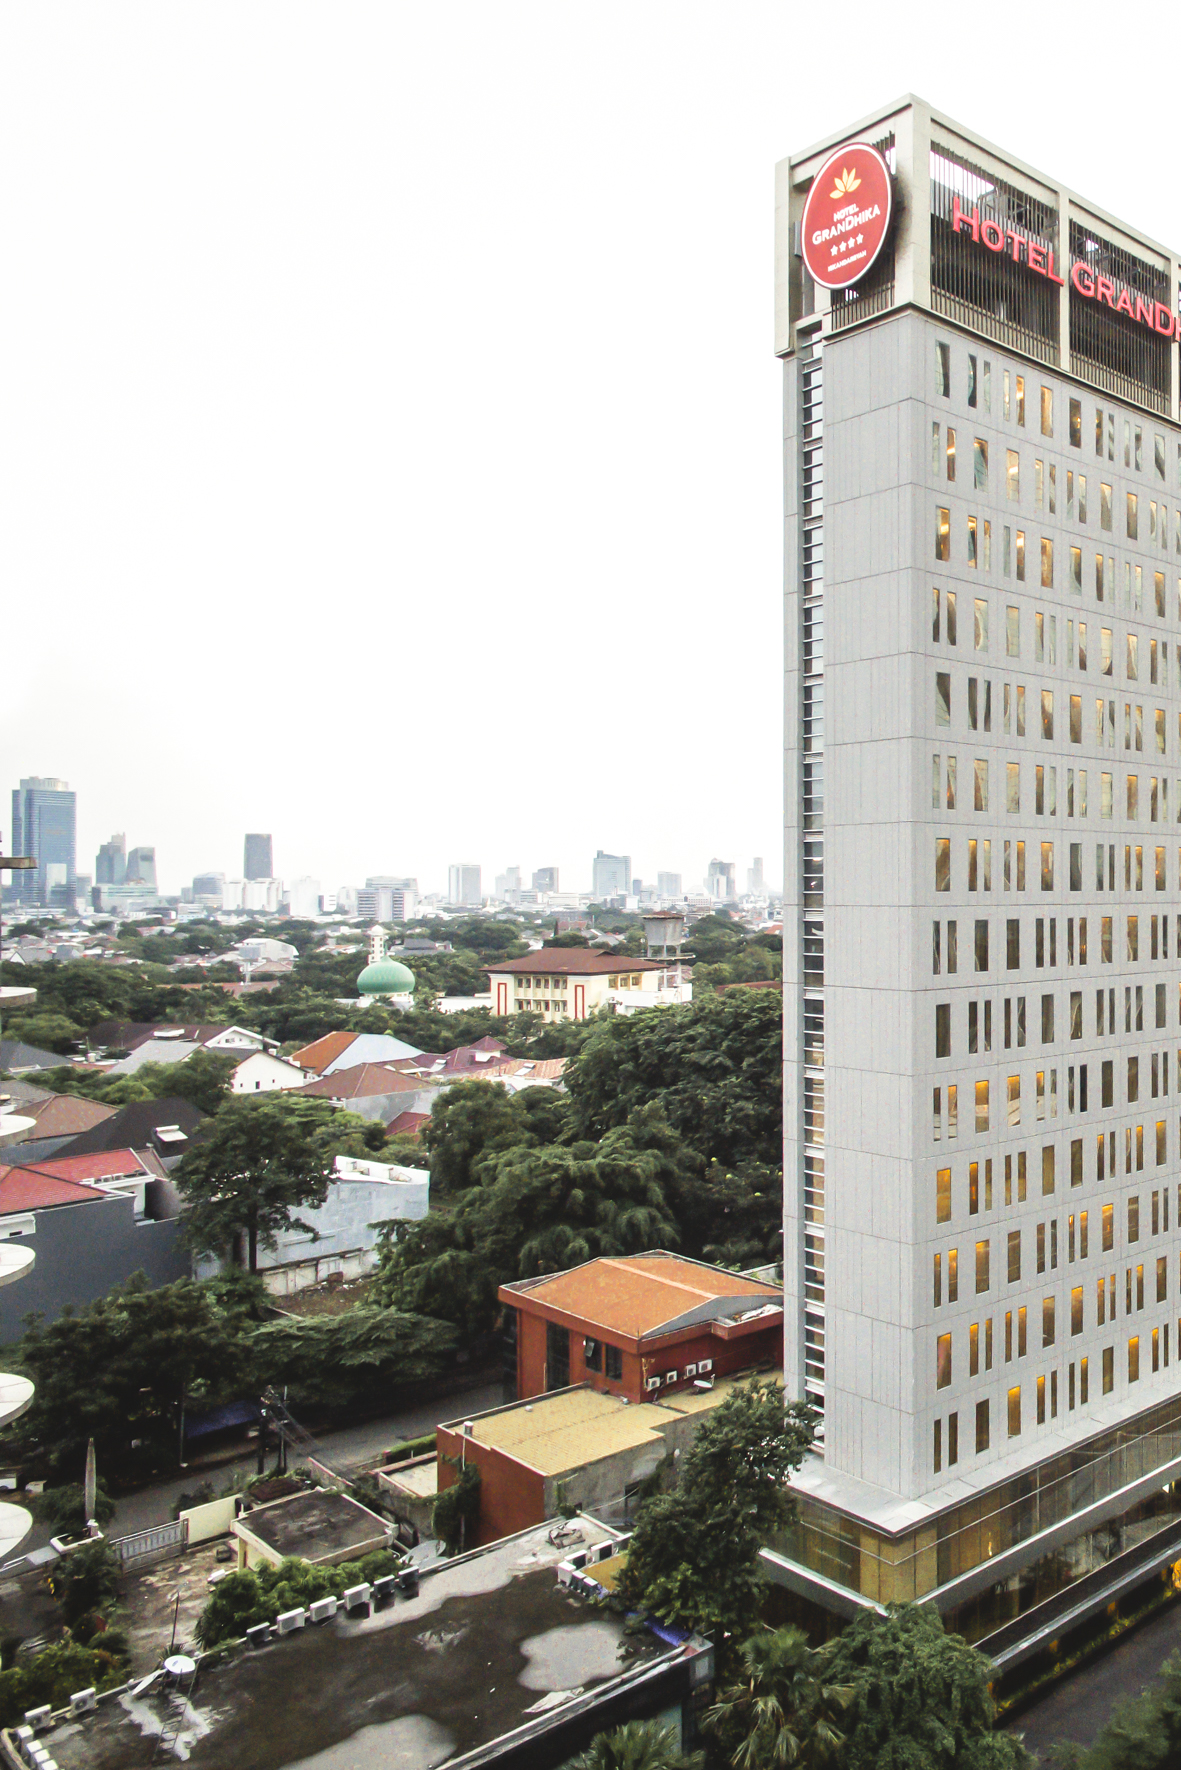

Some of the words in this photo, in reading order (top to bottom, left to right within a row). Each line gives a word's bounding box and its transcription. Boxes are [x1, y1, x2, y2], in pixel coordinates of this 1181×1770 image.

[812, 204, 881, 245] GRANDHIKA
[833, 204, 859, 222] HOTEL
[953, 196, 1065, 287] HOTEL
